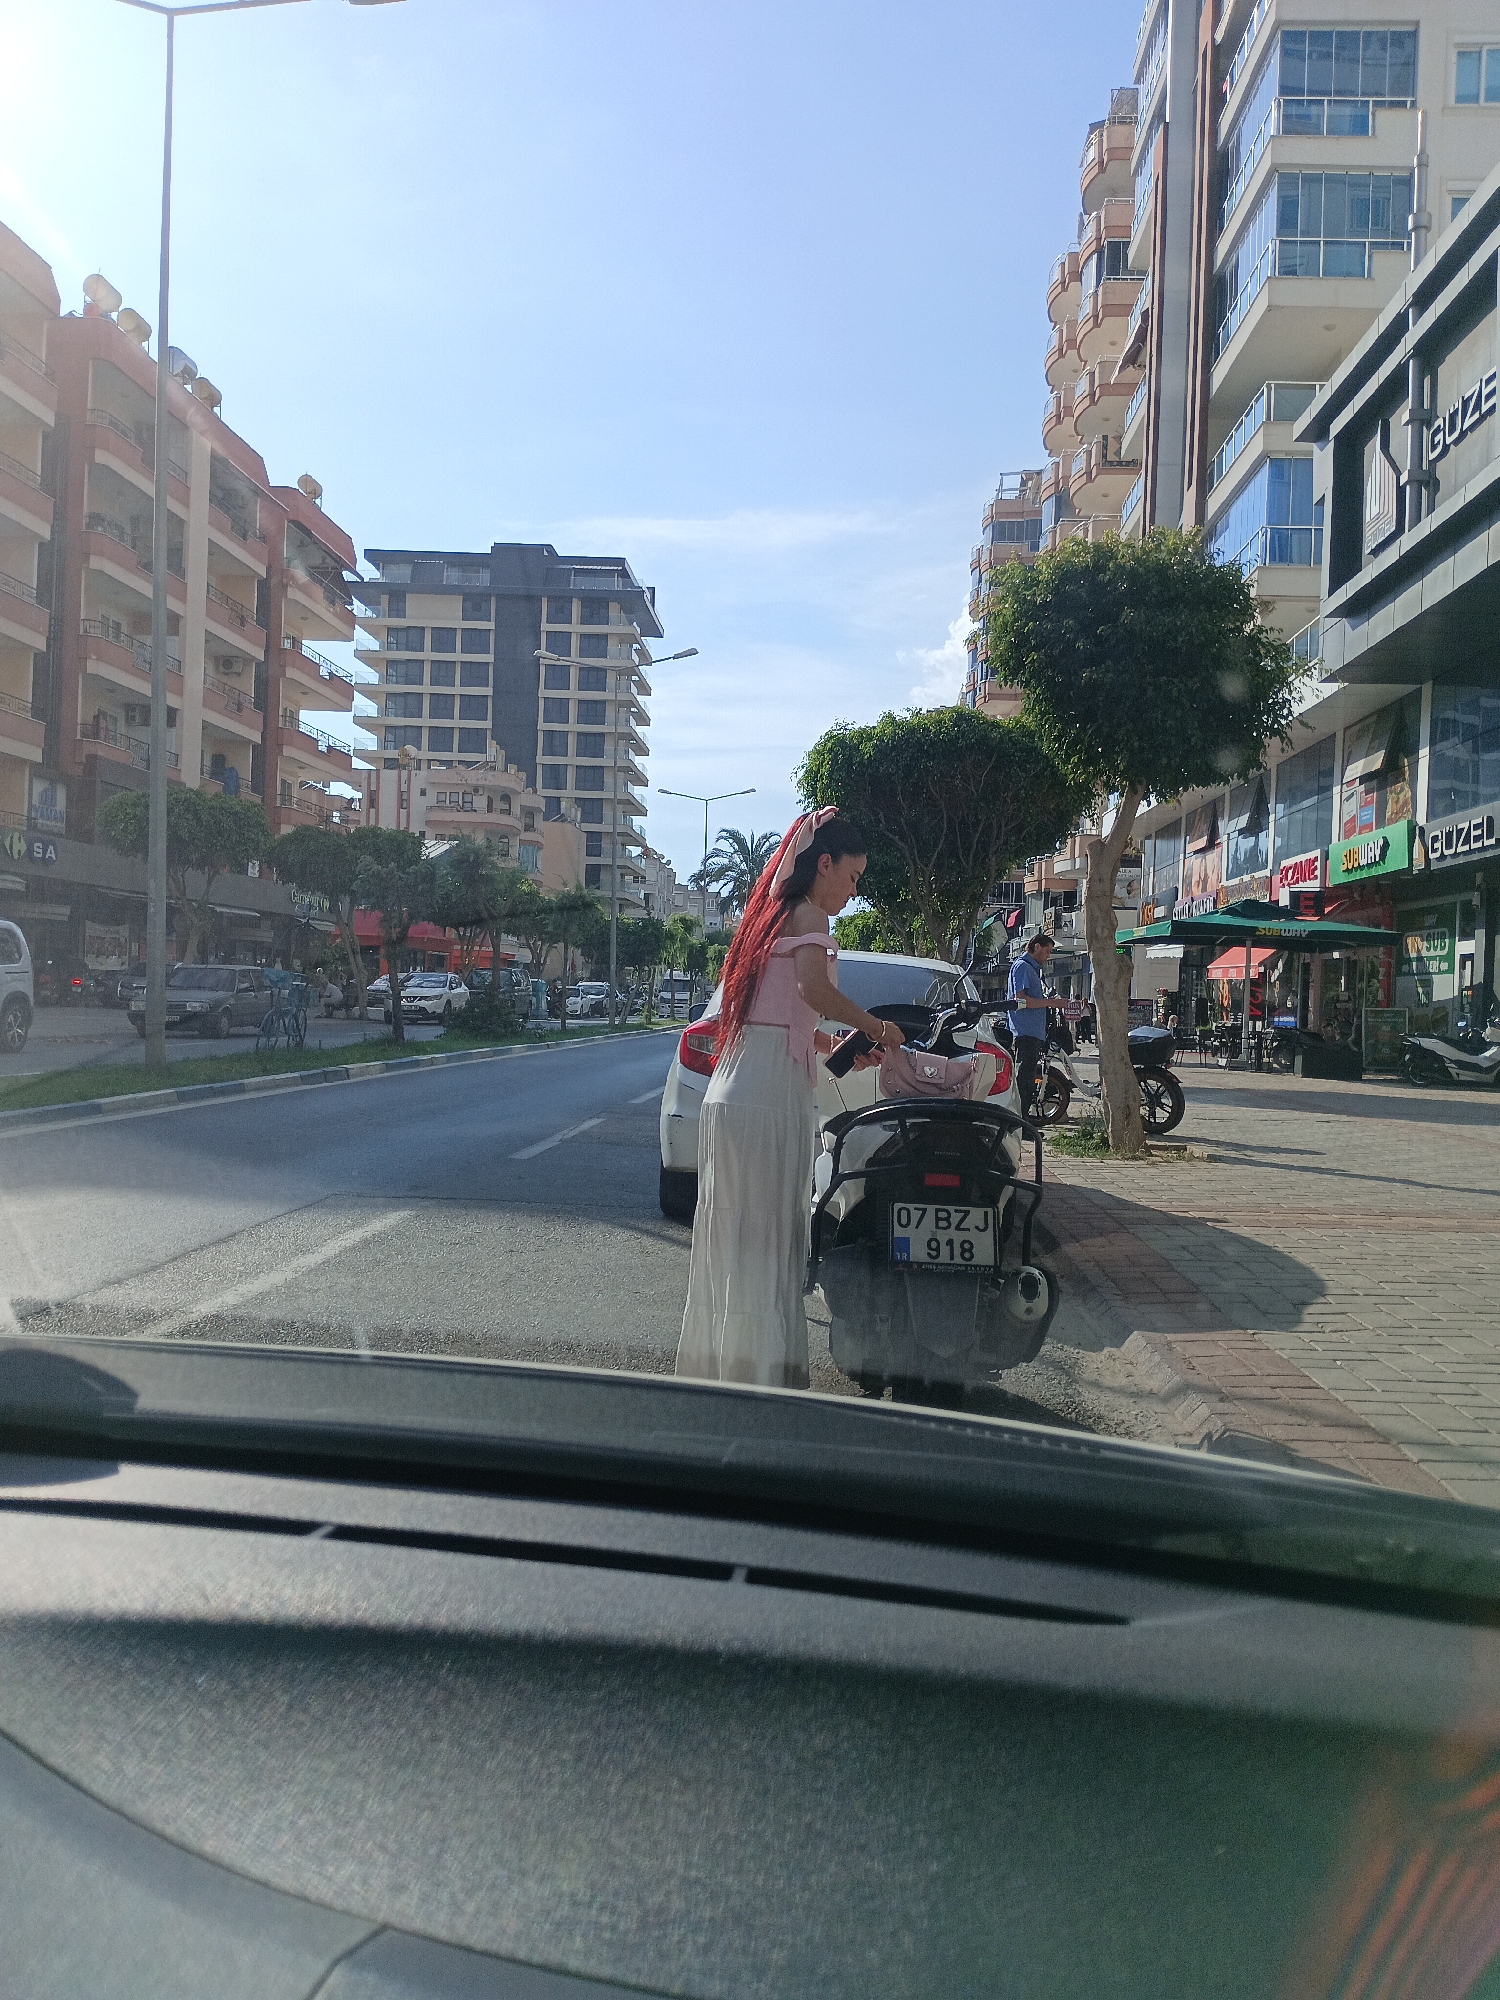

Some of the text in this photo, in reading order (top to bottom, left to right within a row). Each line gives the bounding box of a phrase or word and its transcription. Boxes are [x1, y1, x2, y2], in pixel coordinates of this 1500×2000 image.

[1428, 815, 1496, 859] GÜZEL
[1341, 838, 1383, 872] SUBWAY
[1279, 856, 1319, 888] ECZANE
[1256, 926, 1309, 938] SUBWAY
[1425, 930, 1448, 953] SUB
[896, 1206, 990, 1233] 07 BZJ
[896, 1252, 908, 1261] TR
[926, 1237, 975, 1262] 918
